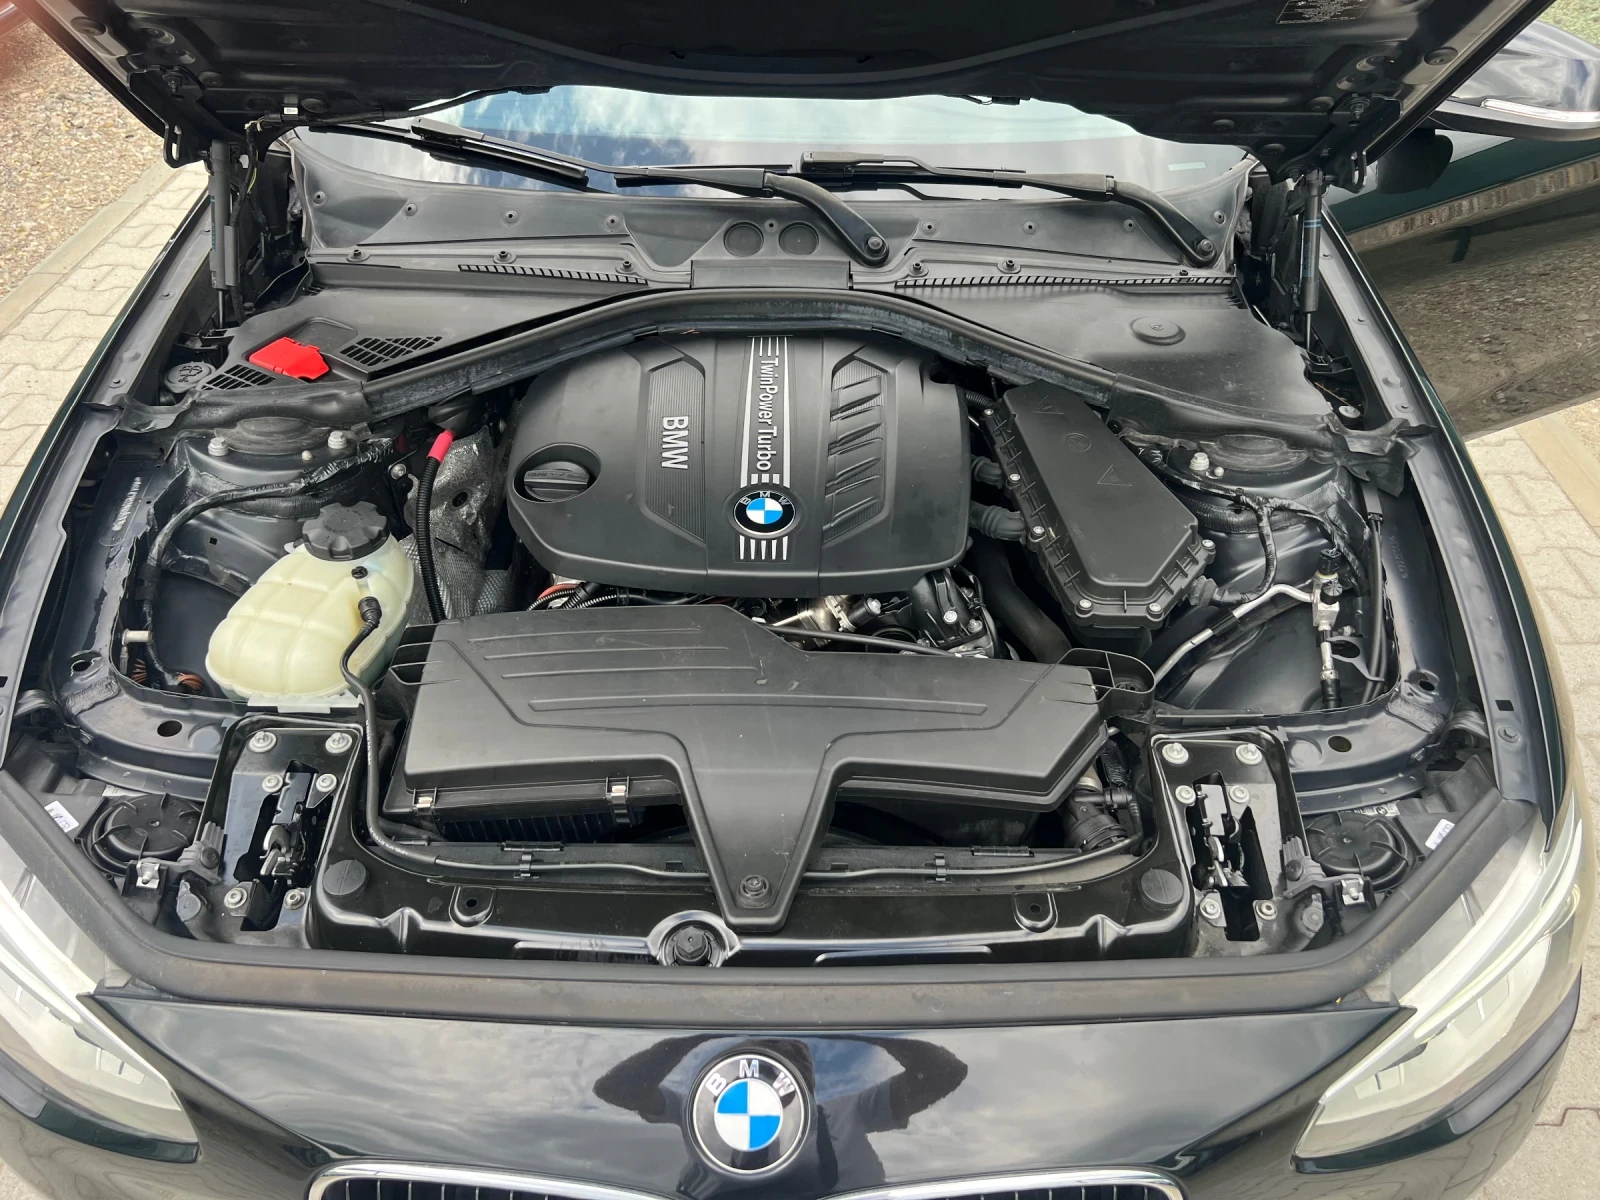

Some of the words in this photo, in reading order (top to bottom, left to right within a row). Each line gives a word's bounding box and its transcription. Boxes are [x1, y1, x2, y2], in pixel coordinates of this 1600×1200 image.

[758, 357, 779, 425] TwinPower
[661, 415, 689, 470] BMW
[756, 425, 777, 471] Turbo
[740, 491, 790, 505] BMW
[705, 1059, 795, 1097] BMW
